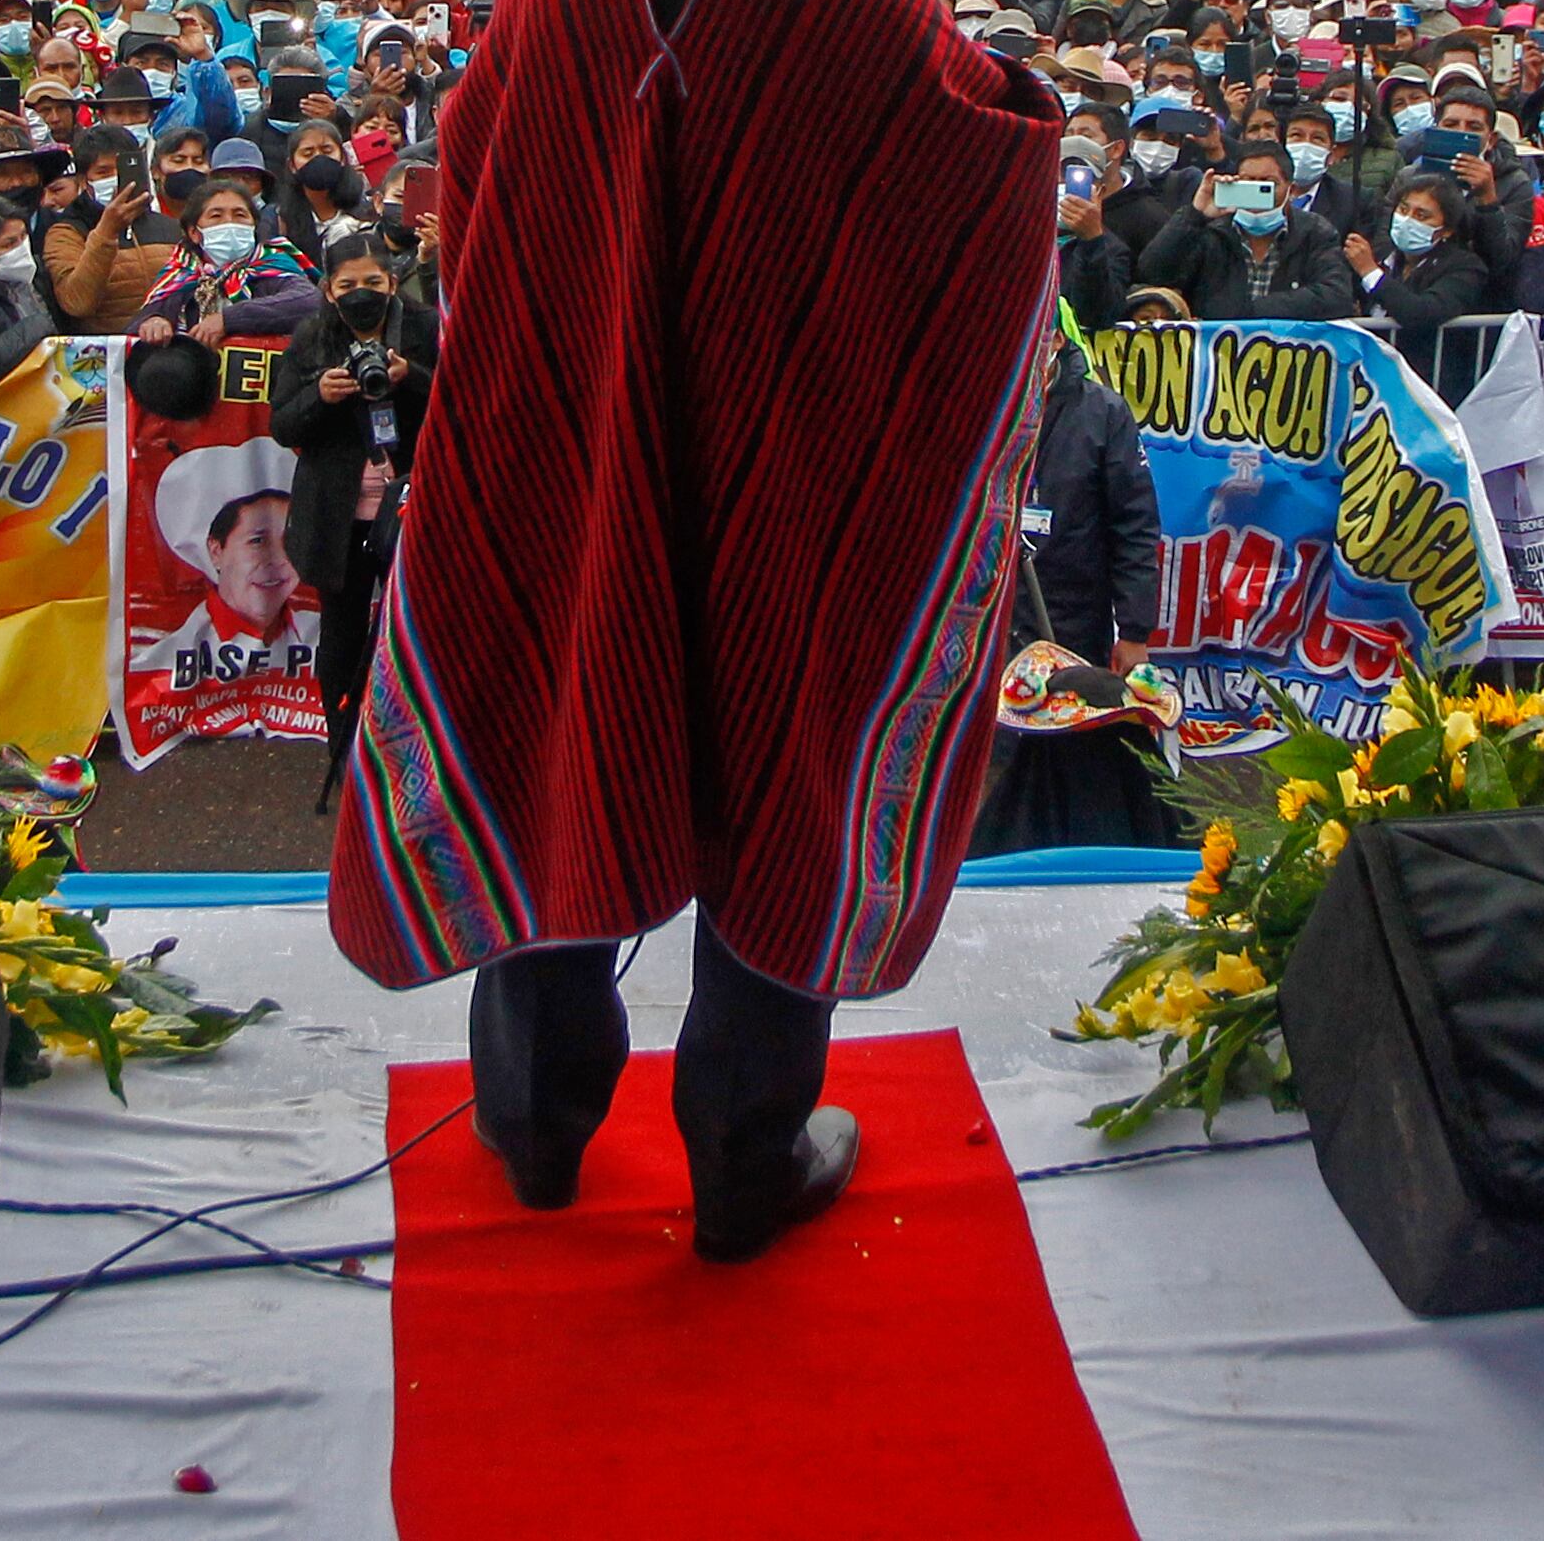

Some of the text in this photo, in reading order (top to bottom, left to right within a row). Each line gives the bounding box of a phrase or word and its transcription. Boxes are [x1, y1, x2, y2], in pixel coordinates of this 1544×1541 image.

[1202, 329, 1330, 461] AGUA
[1337, 407, 1485, 647] DESAGUE
[172, 640, 272, 690] BASE
